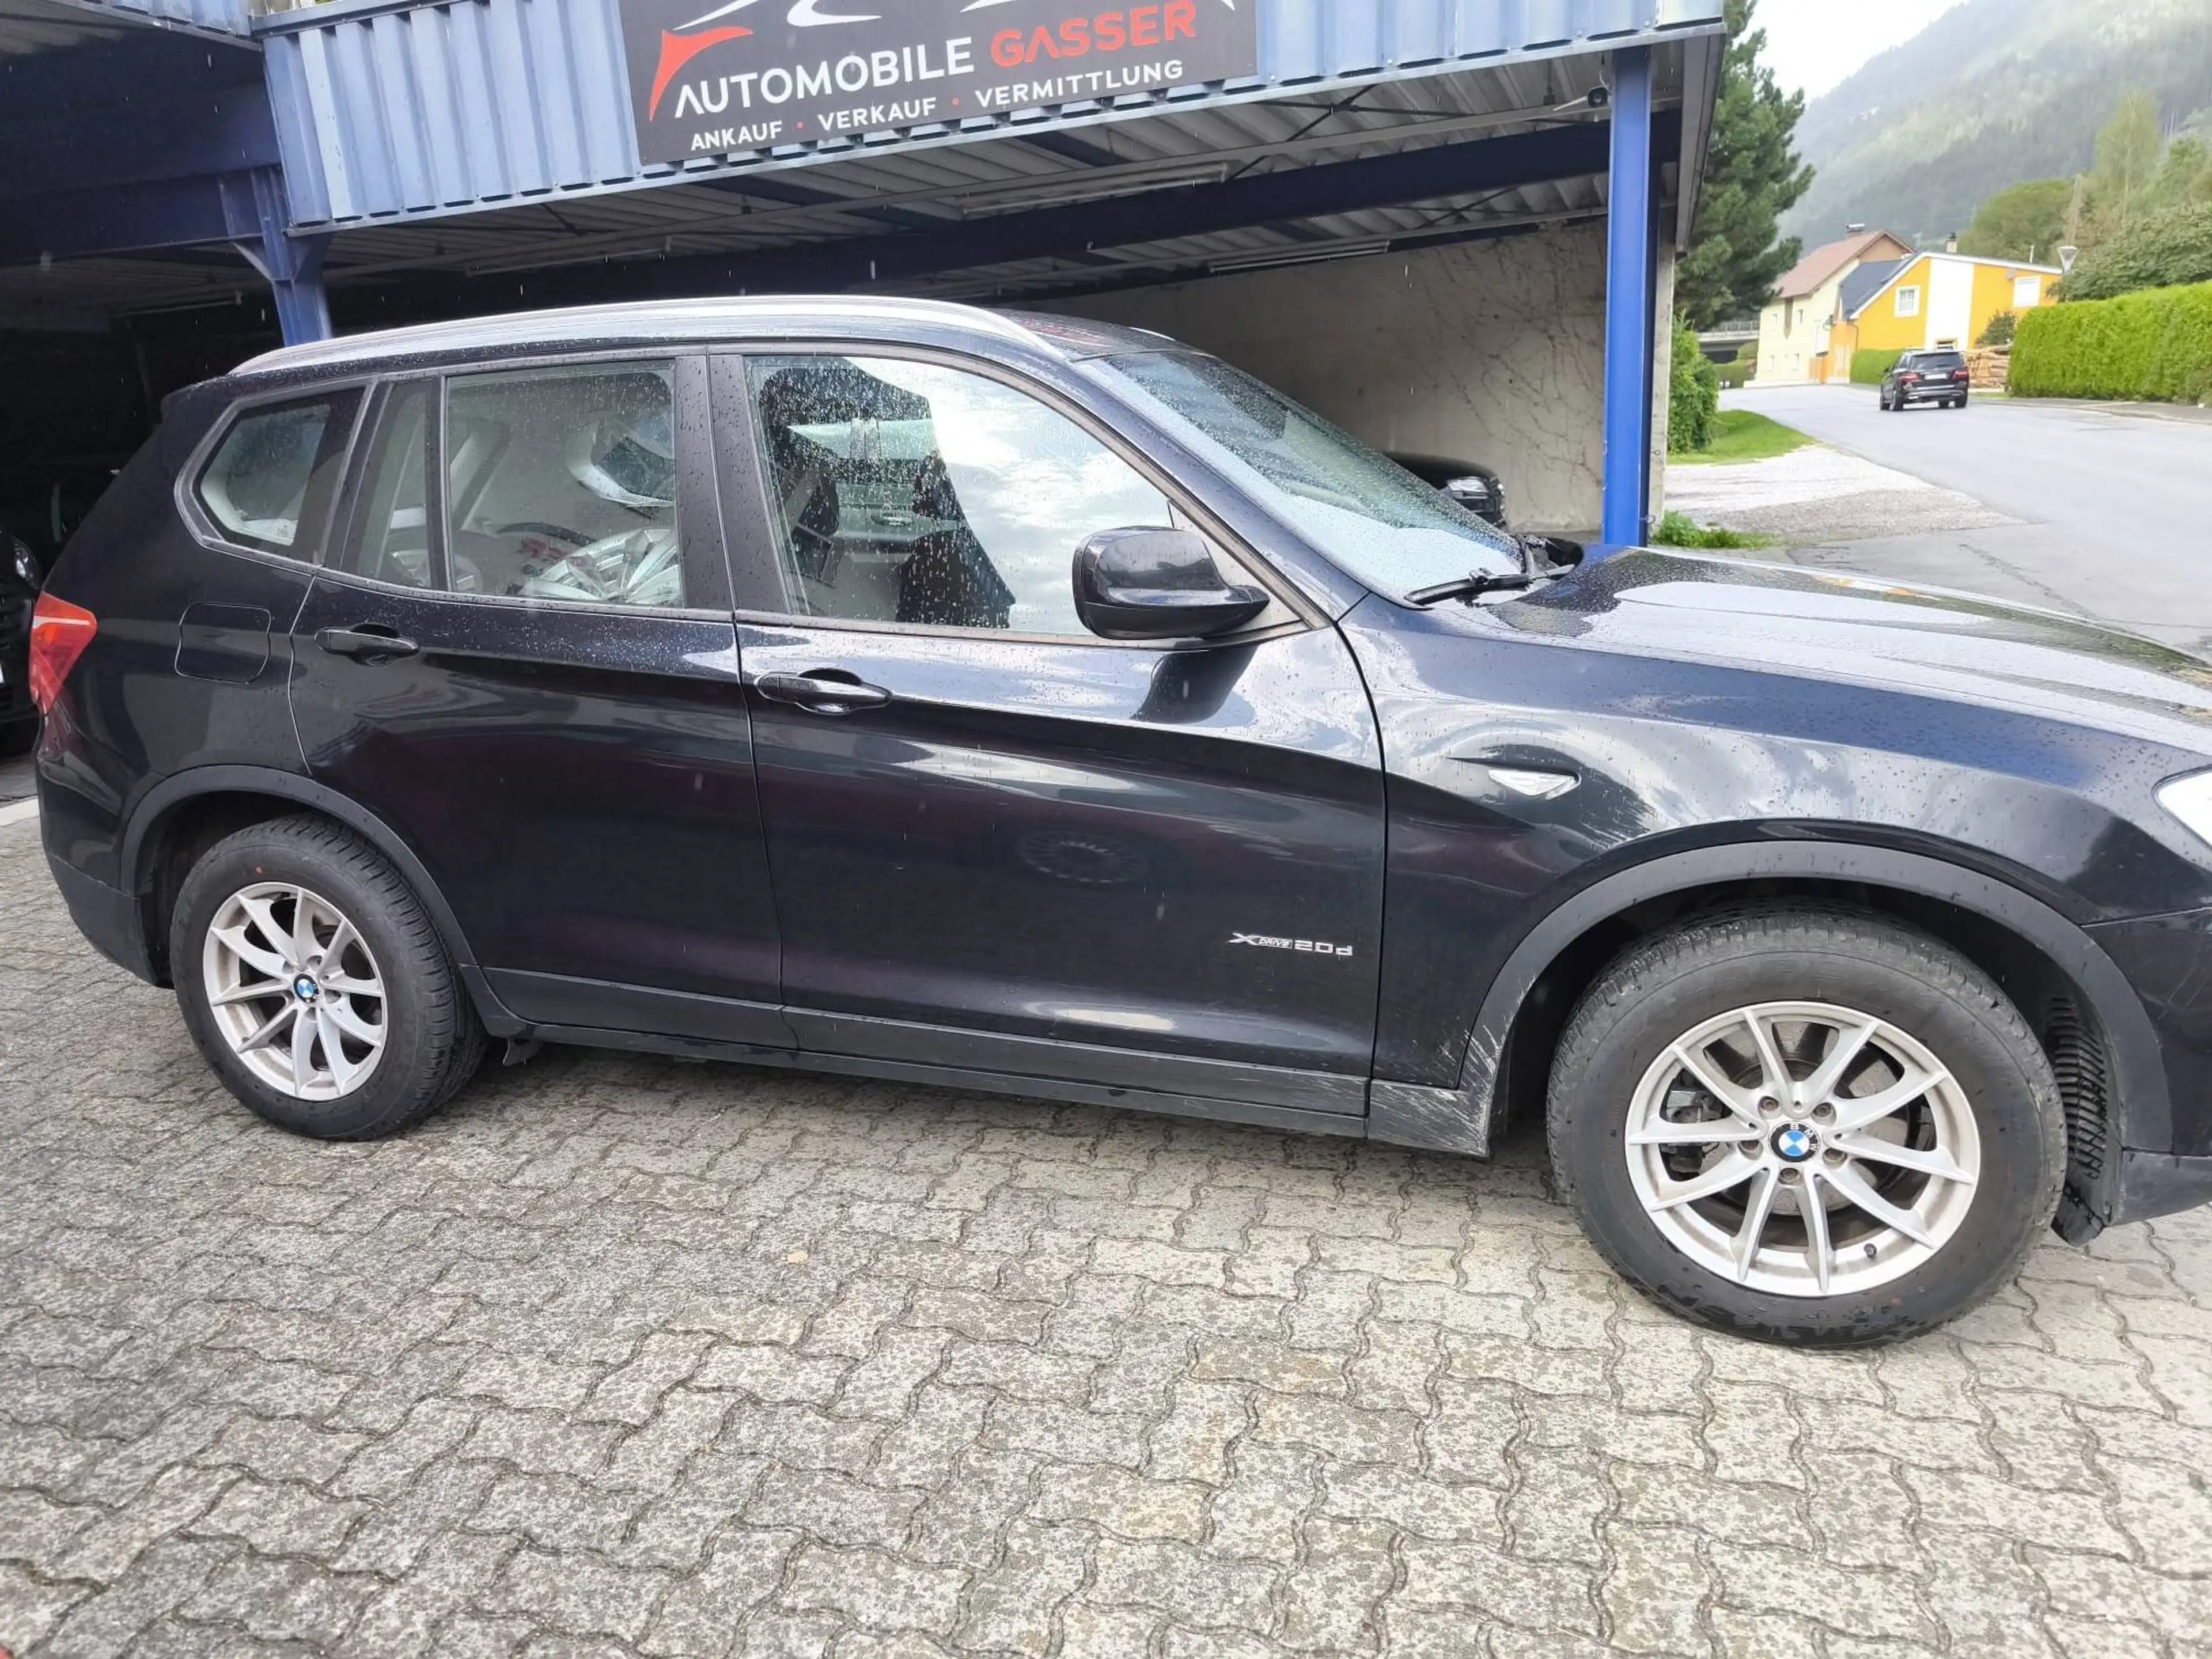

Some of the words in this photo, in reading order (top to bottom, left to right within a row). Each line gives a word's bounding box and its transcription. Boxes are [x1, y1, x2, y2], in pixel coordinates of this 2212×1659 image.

[675, 36, 975, 118] AUTOMOBILE
[991, 0, 1196, 67] GASSER
[691, 120, 782, 150] ANKAUF
[817, 97, 936, 131] VERKAUF
[975, 60, 1183, 108] VERMITTLUNG
